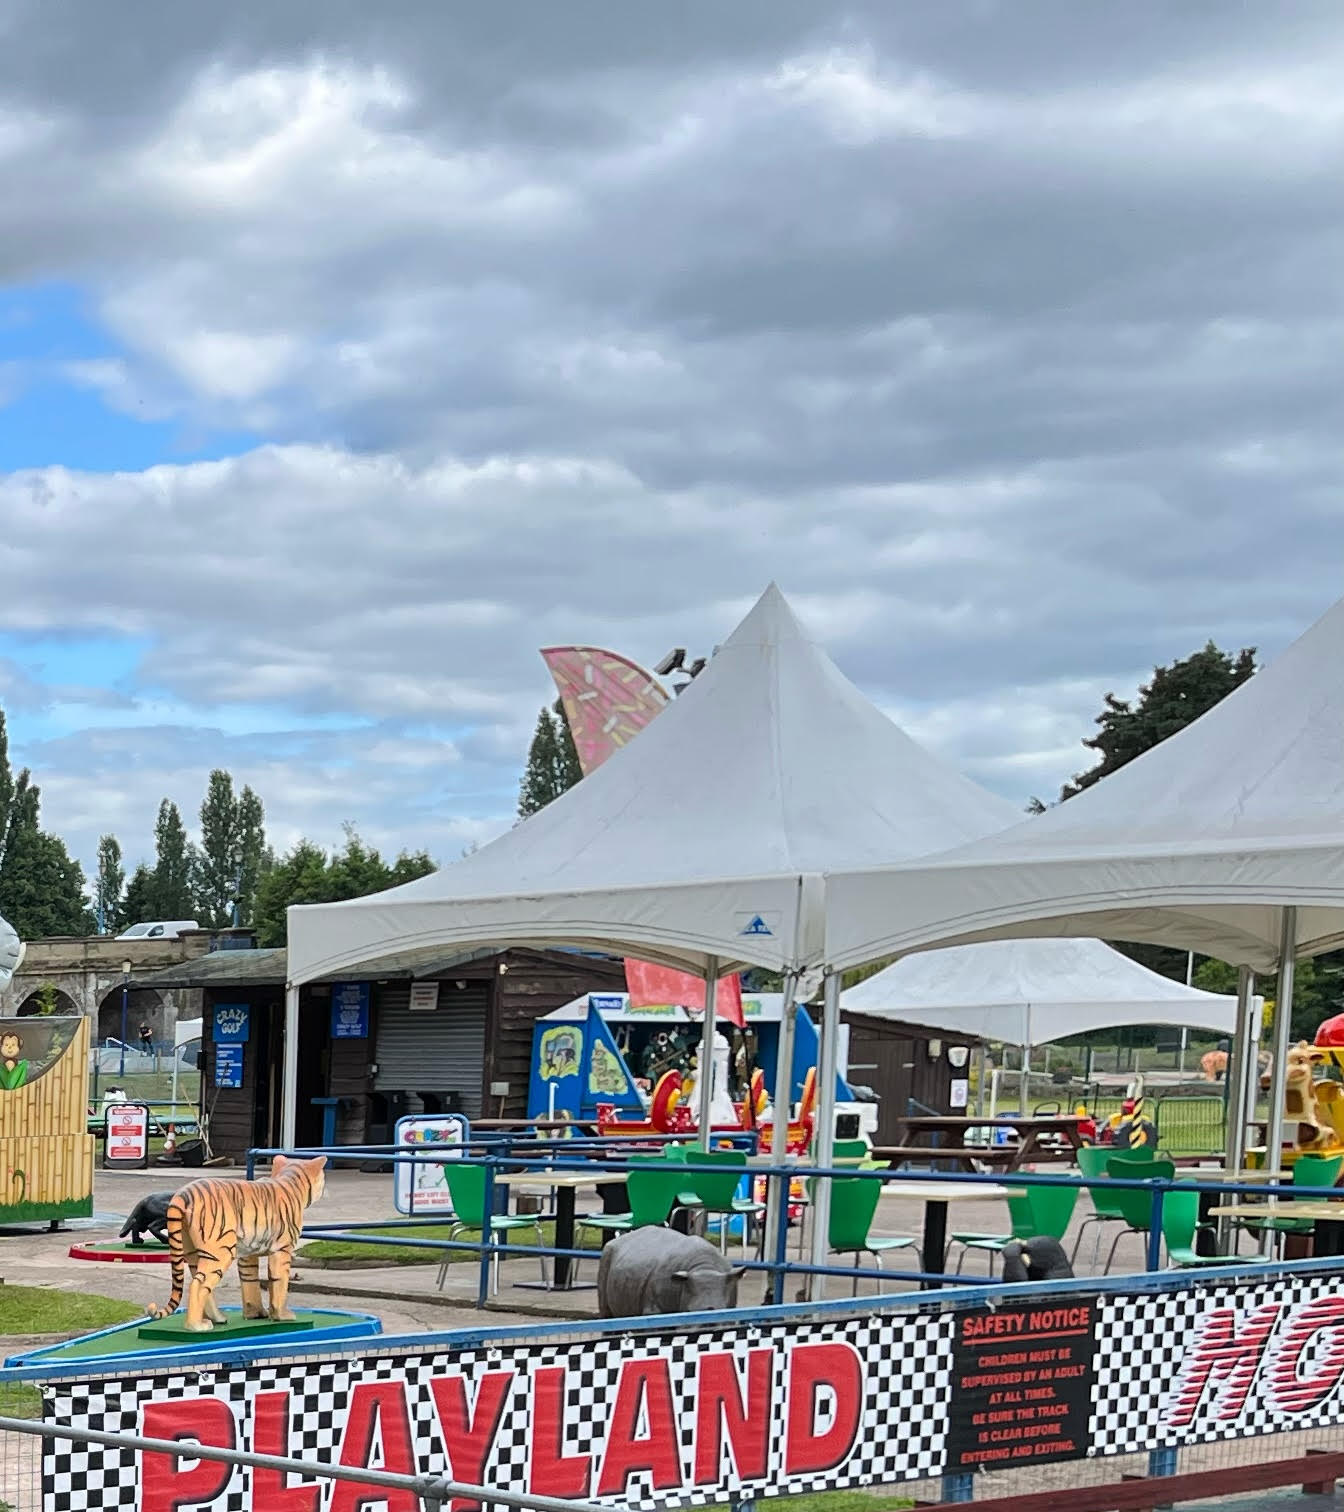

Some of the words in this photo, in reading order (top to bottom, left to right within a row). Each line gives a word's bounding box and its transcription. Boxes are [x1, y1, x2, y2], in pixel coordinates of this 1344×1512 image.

[216, 1009, 248, 1025] CRAZY
[222, 1022, 241, 1034] GOLF
[962, 1313, 1025, 1336] SAFETY
[1030, 1307, 1090, 1330] NOTICE
[978, 1352, 1027, 1368] CHILDREN
[1029, 1349, 1056, 1363] MUST
[1058, 1348, 1071, 1360] BE
[961, 1371, 1022, 1388] SUPERVISED
[1023, 1370, 1037, 1383] BY
[1039, 1368, 1053, 1380] AN
[1054, 1365, 1086, 1379] ADULT
[988, 1392, 1003, 1405] AT
[1004, 1390, 1022, 1403] ALL
[1024, 1387, 1056, 1400] TIMES.
[972, 1413, 986, 1425] BE
[988, 1409, 1014, 1424] SURE
[1016, 1407, 1035, 1420] THE
[1037, 1403, 1069, 1418] TRACK
[978, 1431, 989, 1444] IS
[991, 1427, 1022, 1442] CLEAR
[1023, 1423, 1061, 1438] BEFORE
[960, 1447, 1010, 1465] ENTERING
[1012, 1445, 1033, 1457] AND
[1034, 1440, 1076, 1456] EXITING.
